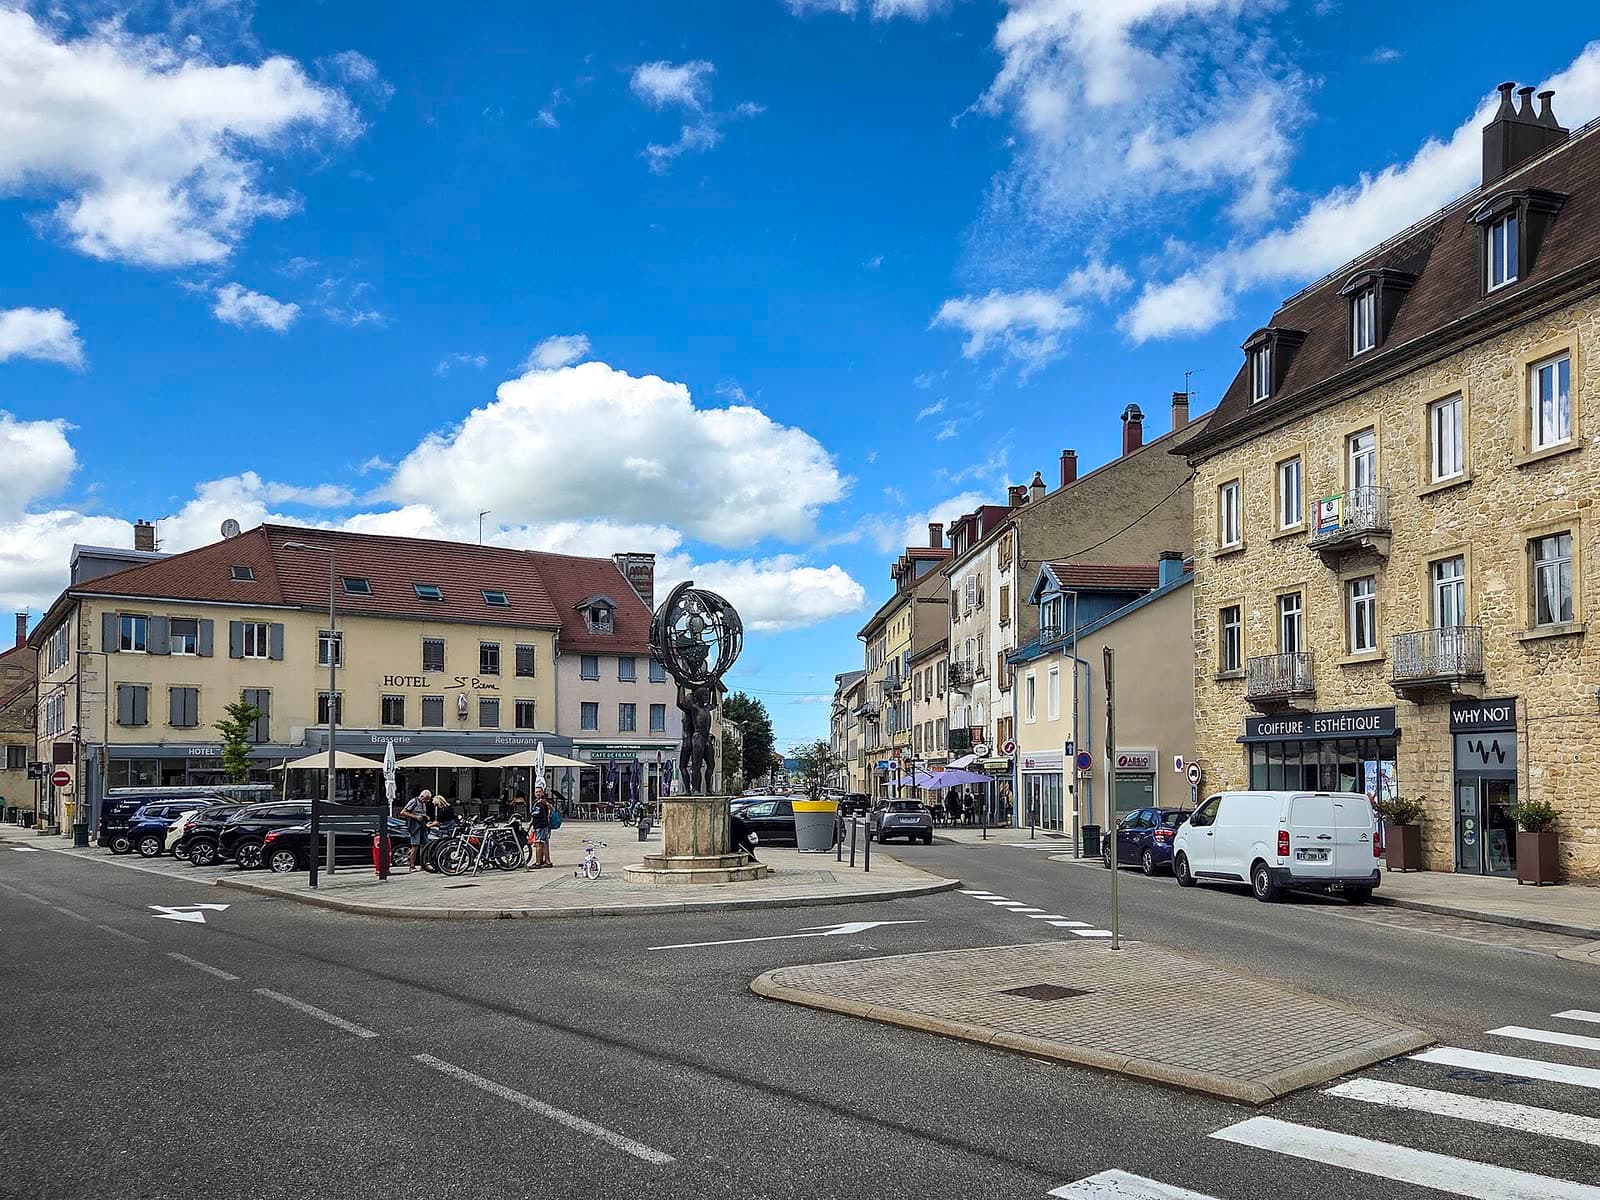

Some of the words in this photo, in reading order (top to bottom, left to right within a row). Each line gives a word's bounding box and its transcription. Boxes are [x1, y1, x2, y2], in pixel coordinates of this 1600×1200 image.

[384, 675, 430, 687] HOTEL
[1453, 709, 1480, 723] WHY
[1483, 707, 1511, 721] NOT
[1257, 721, 1303, 735] COIFFURE
[1314, 715, 1380, 732] ESTHÉTIQUE
[371, 735, 410, 743] Brasserie
[495, 736, 537, 744] Restaurant
